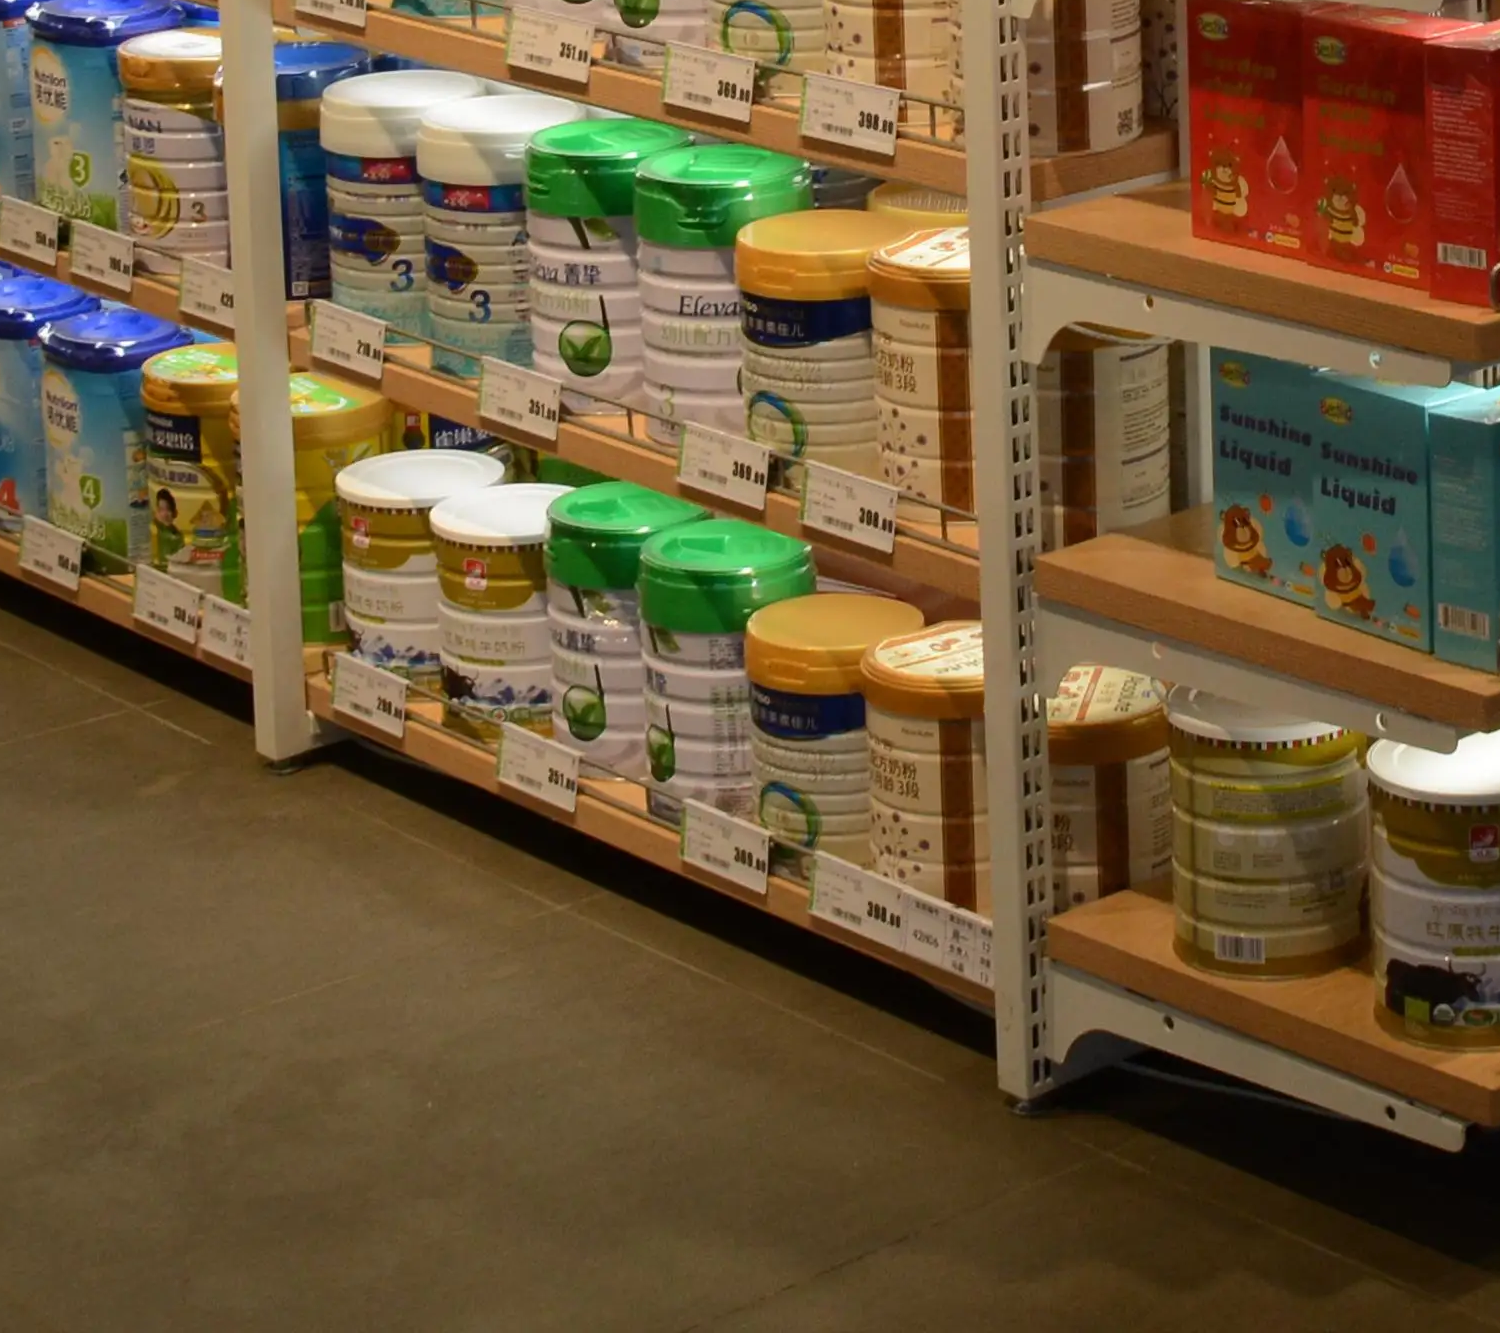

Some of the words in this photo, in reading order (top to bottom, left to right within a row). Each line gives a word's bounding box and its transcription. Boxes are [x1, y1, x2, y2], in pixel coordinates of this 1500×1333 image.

[390, 259, 415, 292] 3
[468, 289, 492, 324] 3
[679, 294, 740, 318] Eleva
[1219, 404, 1313, 450] Sunshine
[1219, 438, 1292, 478] Liquid
[1319, 439, 1419, 487] Sunshine
[1319, 475, 1398, 517] Liquid
